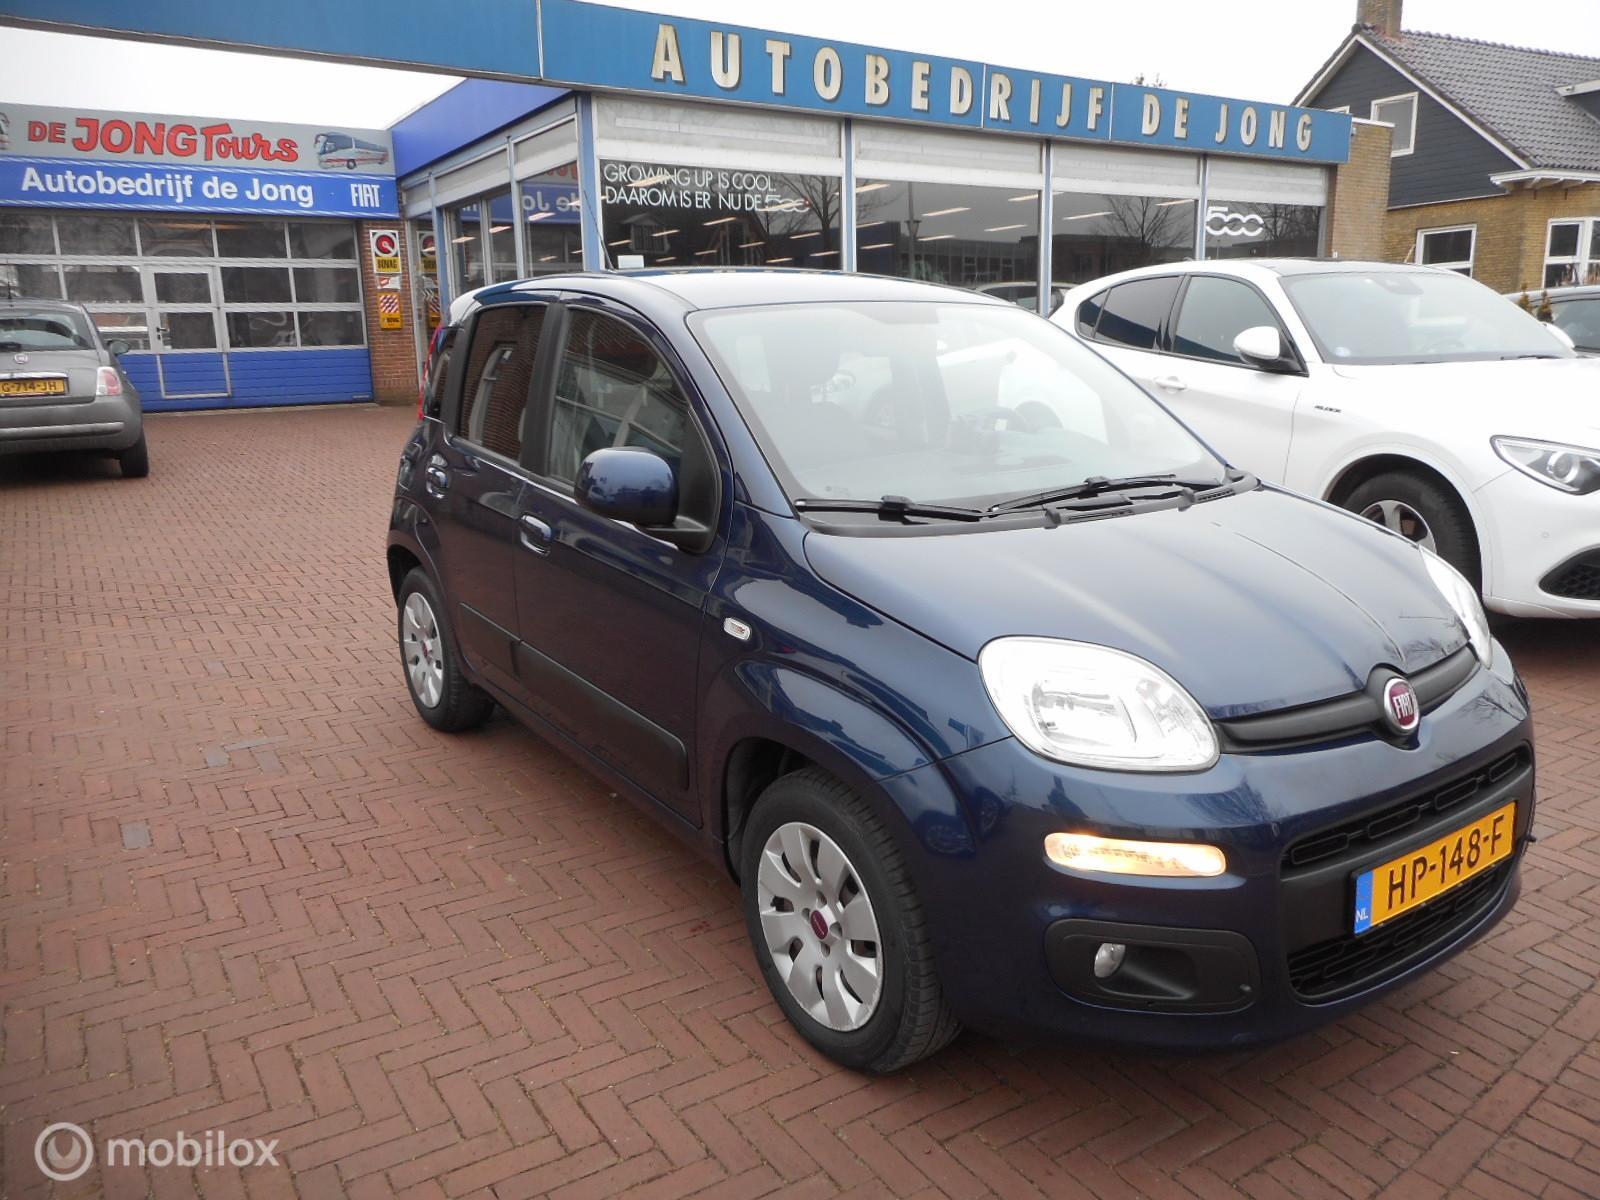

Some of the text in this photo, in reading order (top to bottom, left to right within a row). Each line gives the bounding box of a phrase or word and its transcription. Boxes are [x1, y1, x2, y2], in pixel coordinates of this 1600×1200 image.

[651, 23, 1313, 152] AUTOBEDRIJF DE JONG
[27, 117, 299, 163] DE JONG Tours
[21, 166, 314, 208] Autobedrijf de Jong
[603, 163, 691, 187] GROWING
[695, 170, 713, 188] UP
[718, 172, 730, 189] IS
[350, 183, 381, 208] FIAT
[605, 185, 678, 207] DAAROM
[680, 190, 692, 208] IS
[696, 192, 711, 209] ER
[1205, 206, 1264, 236] 500
[1392, 692, 1414, 719] FIAT
[1387, 814, 1505, 910] HP-148-F
[1355, 908, 1369, 922] NL
